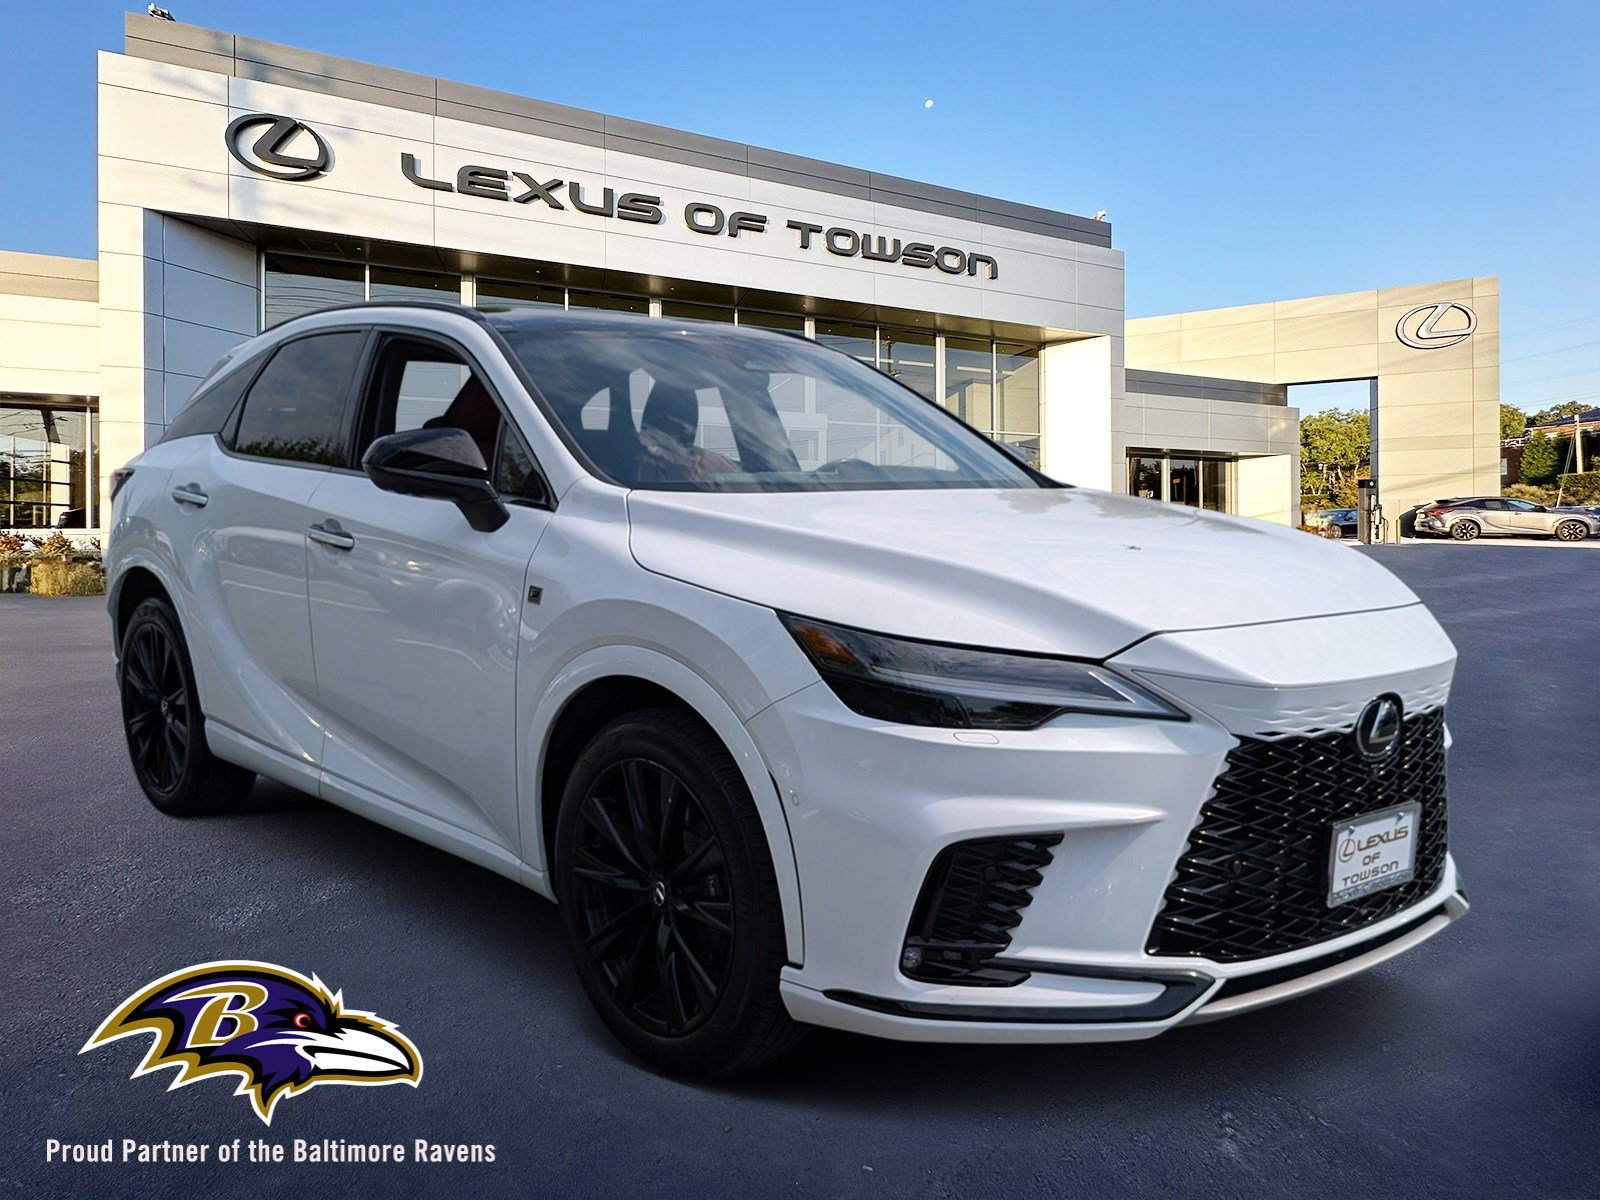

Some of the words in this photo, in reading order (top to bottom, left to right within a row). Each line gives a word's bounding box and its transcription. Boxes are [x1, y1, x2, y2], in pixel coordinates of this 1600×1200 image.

[401, 152, 662, 225] LEXUS
[684, 202, 767, 237] OF
[787, 219, 999, 279] TOWSON
[1357, 825, 1409, 851] LEXUS
[1362, 852, 1381, 866] OF
[1342, 860, 1399, 886] TOWSON
